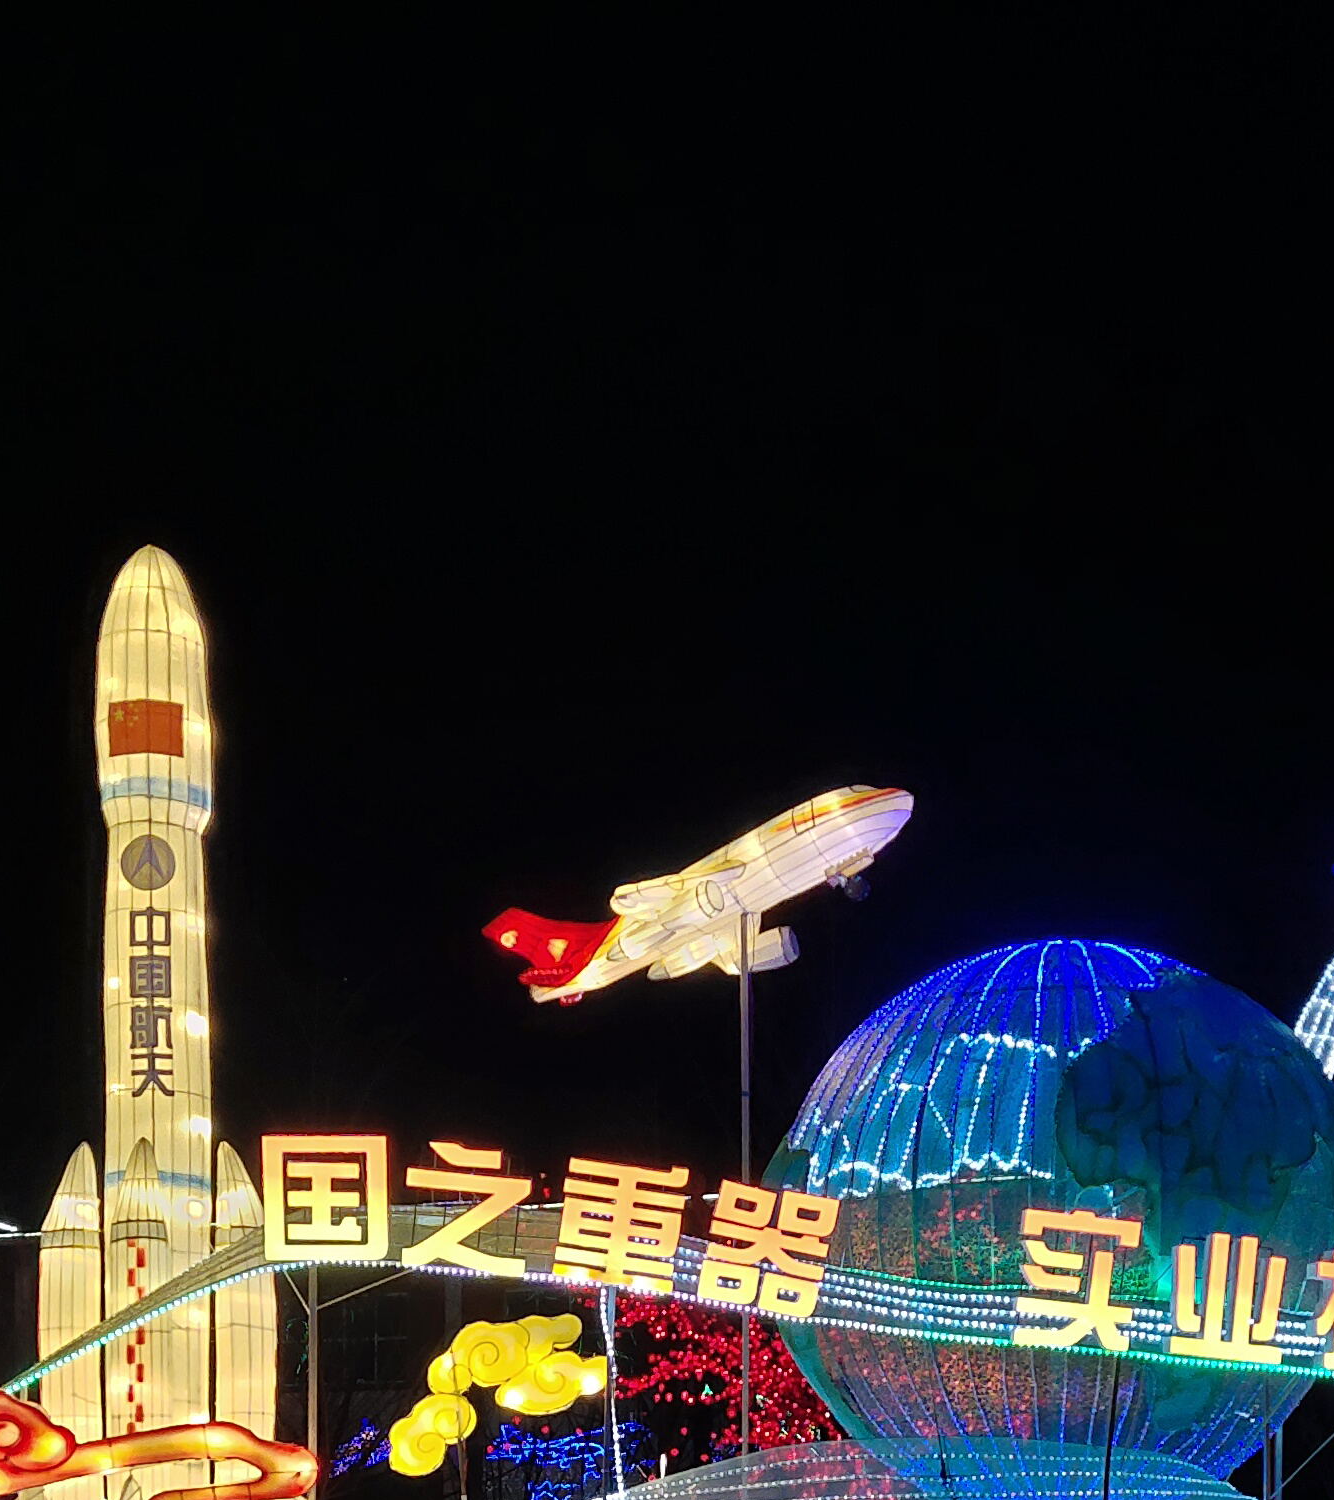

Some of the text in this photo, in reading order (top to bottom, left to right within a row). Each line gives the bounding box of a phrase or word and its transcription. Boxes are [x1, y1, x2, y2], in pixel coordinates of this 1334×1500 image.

[130, 906, 174, 1097] 中国航天
[262, 1134, 840, 1318] 国之重器
